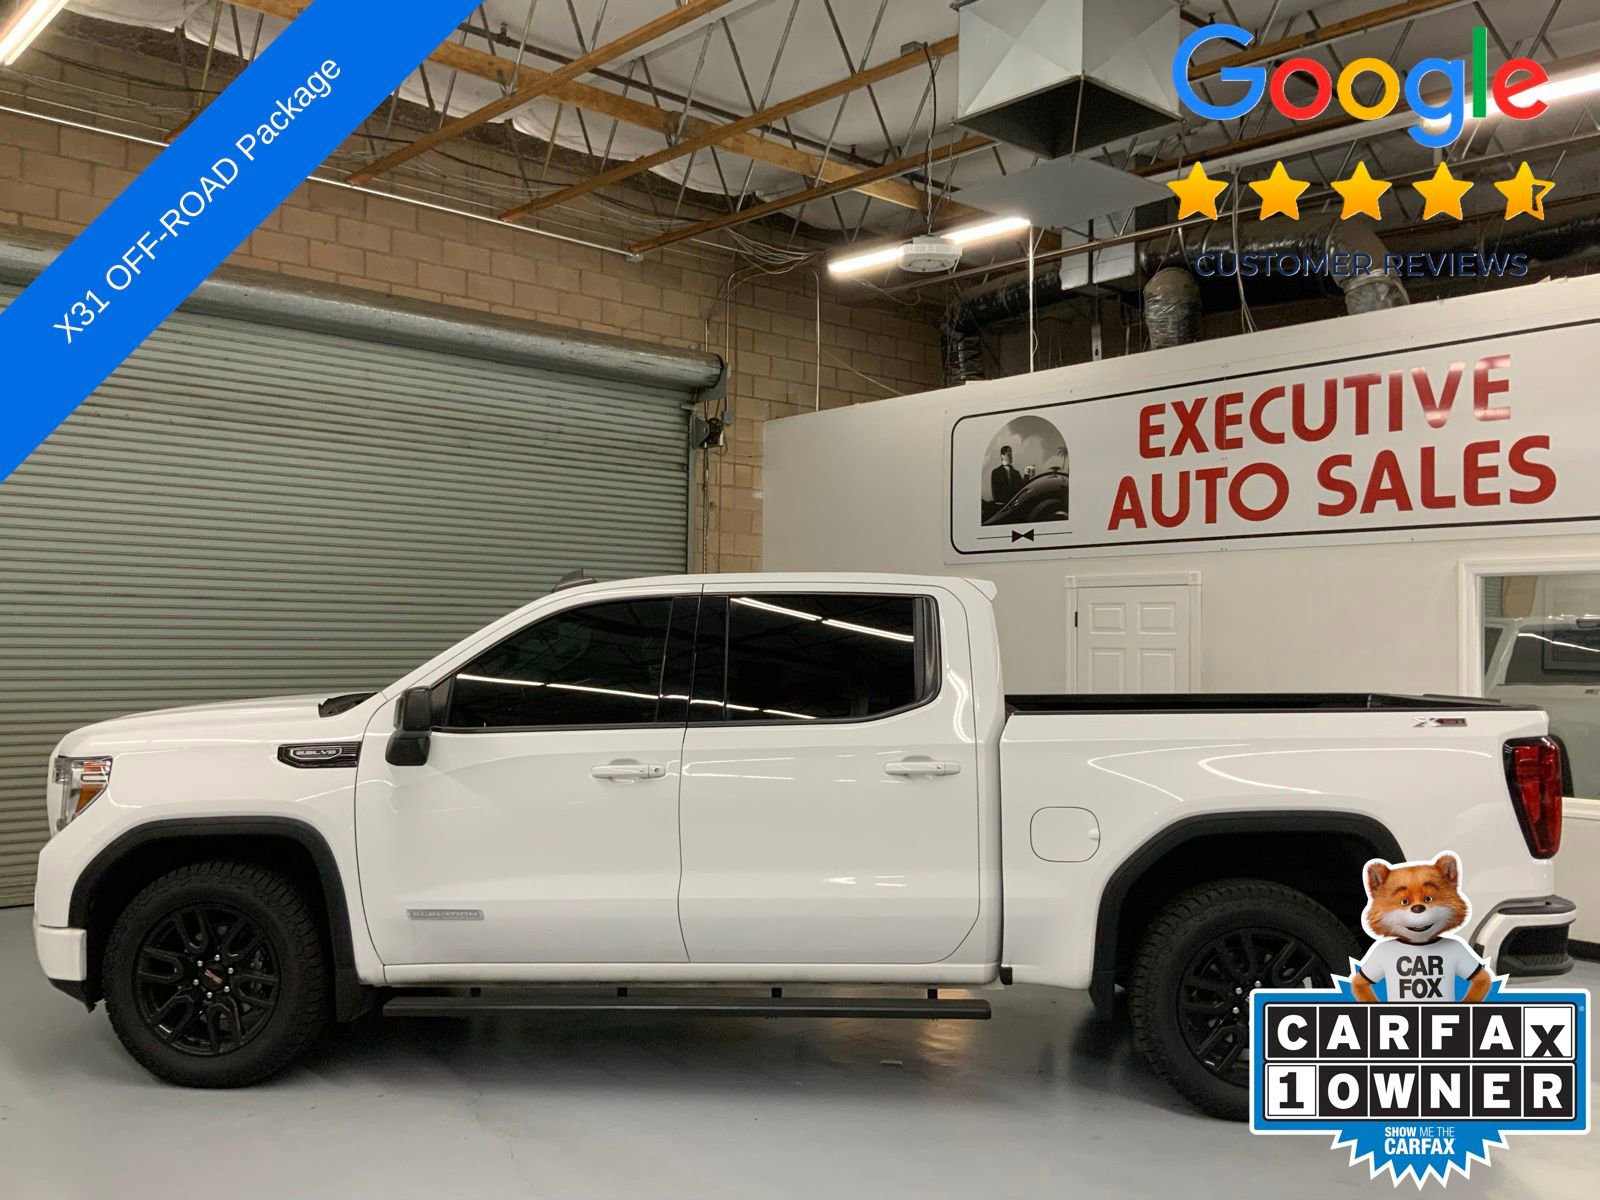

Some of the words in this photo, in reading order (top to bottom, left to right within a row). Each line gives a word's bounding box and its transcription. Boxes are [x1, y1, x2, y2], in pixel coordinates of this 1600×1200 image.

[1138, 354, 1512, 460] EXECUTIVE
[1107, 461, 1290, 532] AUTO
[1316, 435, 1558, 518] SALES
